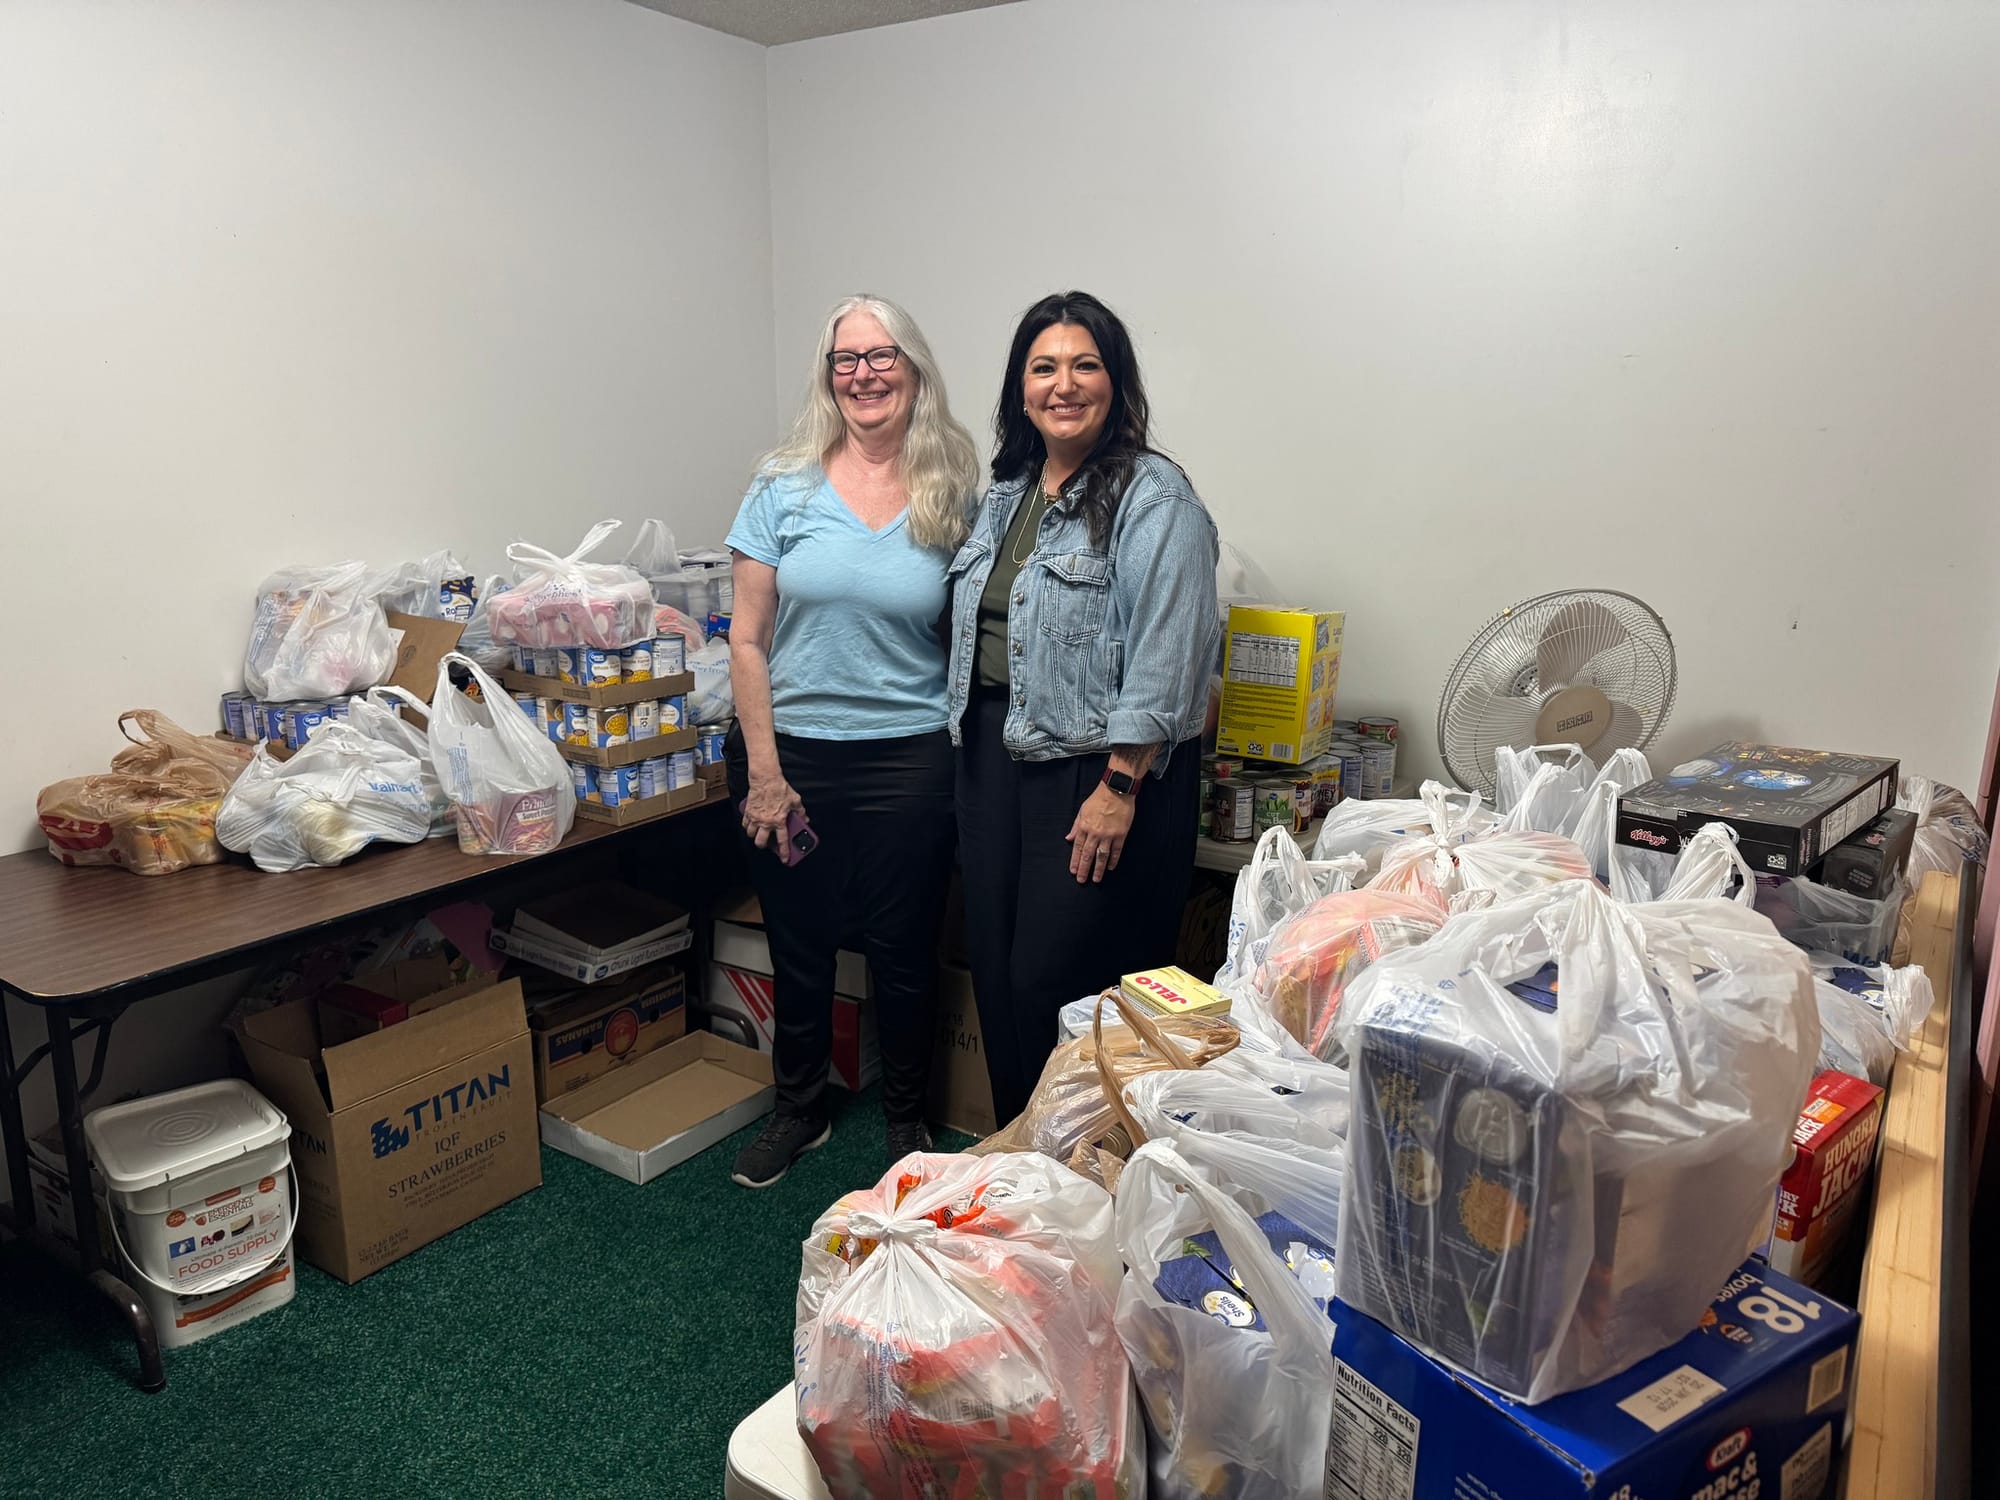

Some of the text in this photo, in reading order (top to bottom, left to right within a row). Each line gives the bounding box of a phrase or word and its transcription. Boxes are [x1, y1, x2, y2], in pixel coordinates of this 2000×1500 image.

[1630, 829, 1669, 845] Kellogg's
[1134, 975, 1188, 1005] JELL-O
[404, 1064, 511, 1132] TITAN
[415, 1091, 513, 1142] FROZEN FRUIT
[295, 1129, 328, 1156] TAN
[434, 1131, 461, 1154] IQF
[1793, 1118, 1826, 1145] JACK
[1823, 1109, 1878, 1176] HUNGRY
[387, 1130, 507, 1199] STRAWBERRIES
[1812, 1137, 1874, 1219] JACK
[178, 1253, 225, 1279] FOOD
[227, 1230, 279, 1260] SUPPLY
[1219, 1296, 1245, 1318] Shells
[1737, 1286, 1823, 1334] 18
[1337, 1364, 1416, 1433] Nutrition Facts
[1715, 1437, 1743, 1463] Kraft
[1692, 1466, 1741, 1500] mac
[1740, 1451, 1758, 1482] &
